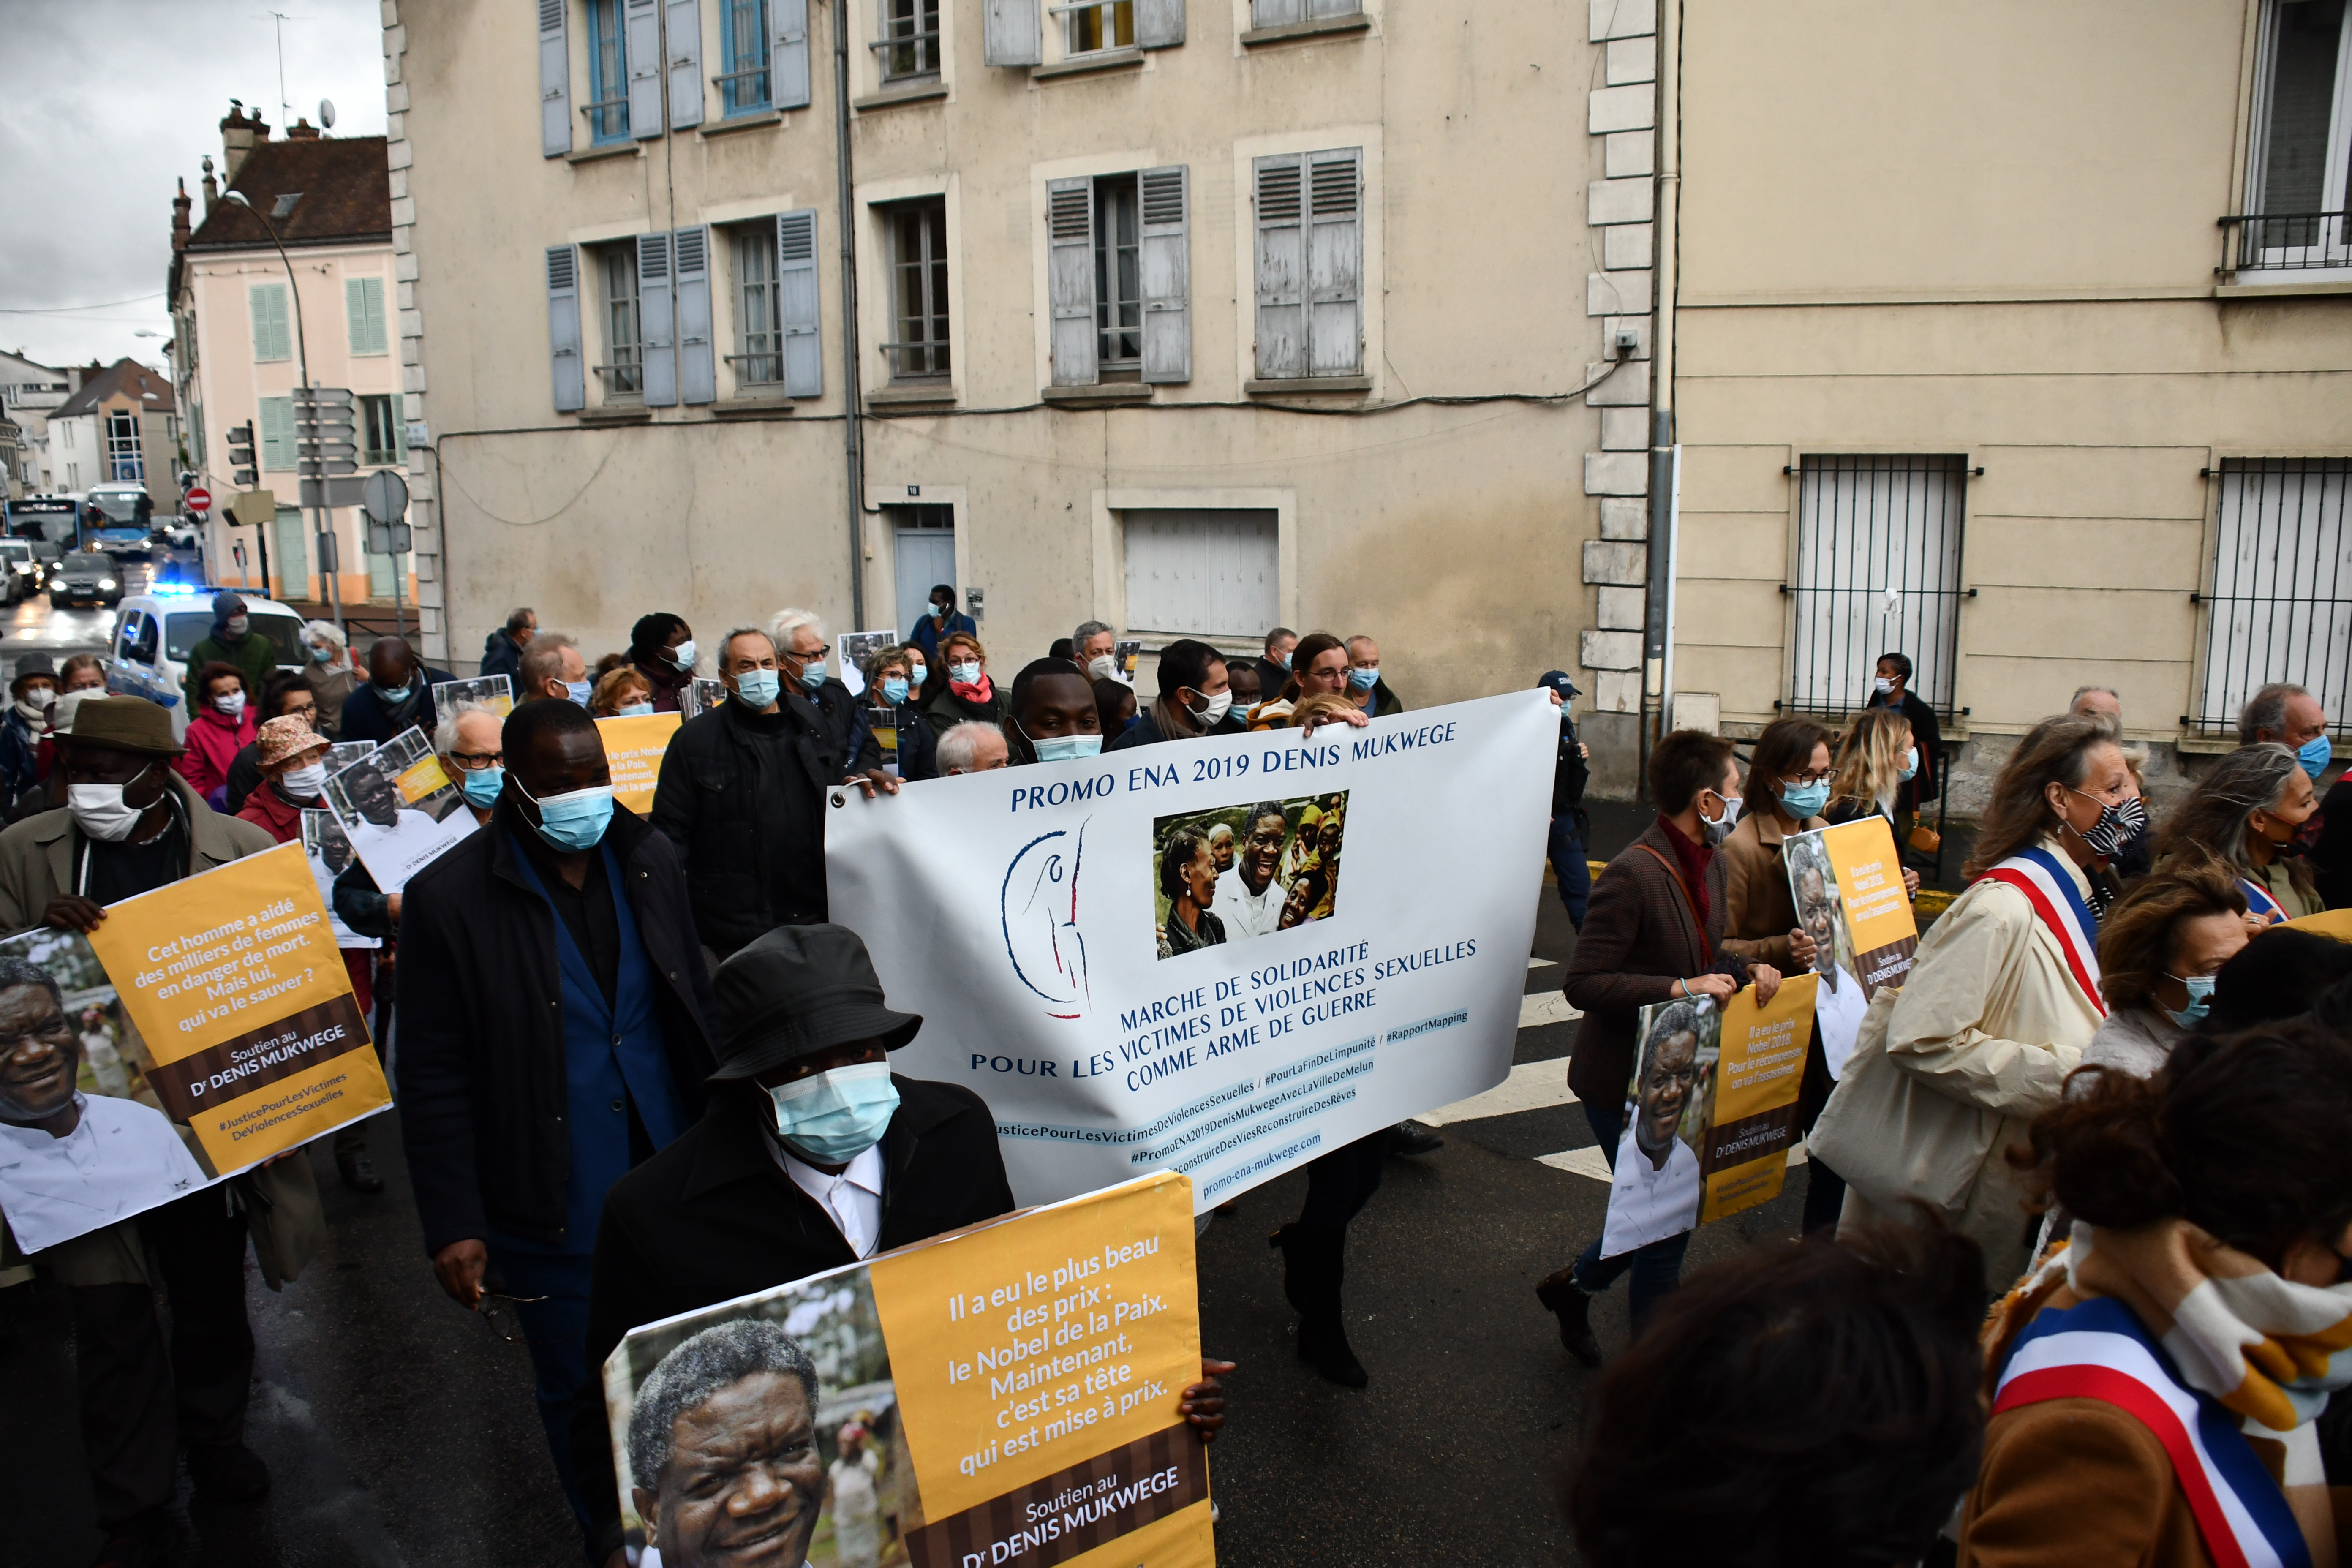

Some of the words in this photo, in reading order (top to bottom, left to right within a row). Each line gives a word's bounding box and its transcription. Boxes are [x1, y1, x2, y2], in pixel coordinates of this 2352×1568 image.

[617, 761, 625, 770] la
[627, 759, 649, 769] Paix.
[621, 749, 639, 760] prix
[1011, 773, 1115, 813] PROMO
[1128, 762, 1180, 792] ENA
[1192, 754, 1250, 783] 2019
[1262, 745, 1340, 773] DENIS
[1351, 721, 1457, 762] MUKWEGE
[629, 782, 638, 791] la
[640, 781, 658, 792] gue
[412, 854, 429, 866] DENIS
[428, 836, 458, 856] MUKWEGE
[135, 968, 165, 988] des
[167, 944, 230, 976] milliers
[232, 936, 253, 952] de
[254, 911, 319, 943] femmes
[148, 941, 180, 962] Cet
[180, 920, 245, 950] homme
[247, 915, 258, 926] a
[260, 898, 295, 922] aidé
[158, 984, 180, 999] en
[182, 959, 239, 991] danger
[242, 952, 264, 967] de
[266, 934, 310, 958] mort.
[206, 976, 248, 1001] Mais
[248, 964, 276, 984] lui,
[1120, 987, 1207, 1033] MARCHE
[1215, 976, 1242, 1002] DE
[1250, 939, 1369, 990] SOLIDARITÉ
[1873, 967, 1892, 982] DENIS
[179, 1009, 207, 1032] qui
[207, 1004, 229, 1020] va
[230, 997, 247, 1011] le
[249, 975, 302, 1004] sauver
[304, 968, 313, 982] ?
[972, 1054, 1058, 1077] POUR
[1073, 1051, 1114, 1078] LES
[1119, 1014, 1211, 1063] VICTIMES
[1220, 1002, 1247, 1028] DE
[1255, 967, 1365, 1015] VIOLENCES
[1375, 939, 1477, 981] SEXUELLES
[1749, 1026, 1756, 1039] Il
[1756, 1028, 1761, 1037] a
[1761, 1025, 1772, 1036] eu
[1772, 1021, 1780, 1033] le
[1780, 1017, 1795, 1033] prix
[190, 1080, 208, 1097] Dr
[210, 1059, 261, 1089] DENIS
[260, 1024, 346, 1069] MUKWEGE
[231, 1037, 280, 1064] Soutien
[281, 1030, 298, 1043] au
[1127, 1046, 1198, 1092] COMME
[1206, 1025, 1261, 1061] ARME
[1269, 1013, 1293, 1038] DE
[1301, 988, 1377, 1026] GUERRE
[1727, 1062, 1747, 1075] Pour
[1748, 1058, 1755, 1070] le
[1747, 1037, 1771, 1054] Nobel
[1771, 1033, 1791, 1049] 2018.
[219, 1073, 347, 1131] #JusticePourLesVictimes
[995, 1081, 1254, 1143] usticePourLesVictimesDeViolencesSexuelles
[1265, 1037, 1376, 1086] #PourLaFinDeLimpunité
[1386, 1010, 1468, 1043] #RapportMapping
[1732, 1078, 1742, 1089] on
[1744, 1076, 1753, 1086] va
[232, 1089, 343, 1141] DeViolencesSexuelles
[1131, 1059, 1374, 1163] #PromoENA2019DenisMukwegeAvecLaVilleDeMelun
[1169, 1087, 1356, 1173] econstruireDesViesReconstruireDesRêves
[1725, 1139, 1748, 1155] DENIS
[1748, 1126, 1786, 1148] MUKWEGE
[1739, 1125, 1761, 1138] Soutien
[1762, 1122, 1769, 1131] au
[1203, 1133, 1321, 1200] promo-ena-mukwege.com
[949, 1294, 965, 1322] Il
[972, 1295, 985, 1315] a
[991, 1283, 1021, 1307] eu
[1026, 1272, 1048, 1296] le
[1054, 1256, 1100, 1292] plus
[1105, 1236, 1159, 1269] beau
[1007, 1304, 1049, 1333] des
[1054, 1285, 1100, 1322] prix
[1105, 1283, 1112, 1300] :
[949, 1361, 971, 1385] le
[977, 1328, 1049, 1375] Nobel
[1055, 1321, 1083, 1347] de
[1089, 1312, 1108, 1335] la
[1114, 1293, 1168, 1326] Paix.
[991, 1333, 1132, 1401] Maintenant,
[1056, 1383, 1081, 1407] sa
[1085, 1364, 1131, 1395] tête
[959, 1439, 998, 1477] qui
[1004, 1426, 1040, 1457] est
[1045, 1407, 1097, 1442] mise
[1103, 1395, 1115, 1419] à
[1120, 1380, 1168, 1416] prix.
[962, 1550, 987, 1568] Dr
[991, 1518, 1060, 1565] DENIS
[1064, 1465, 1179, 1533] MUKWEGE
[1026, 1483, 1094, 1523] Soutien
[1097, 1474, 1117, 1492] au
